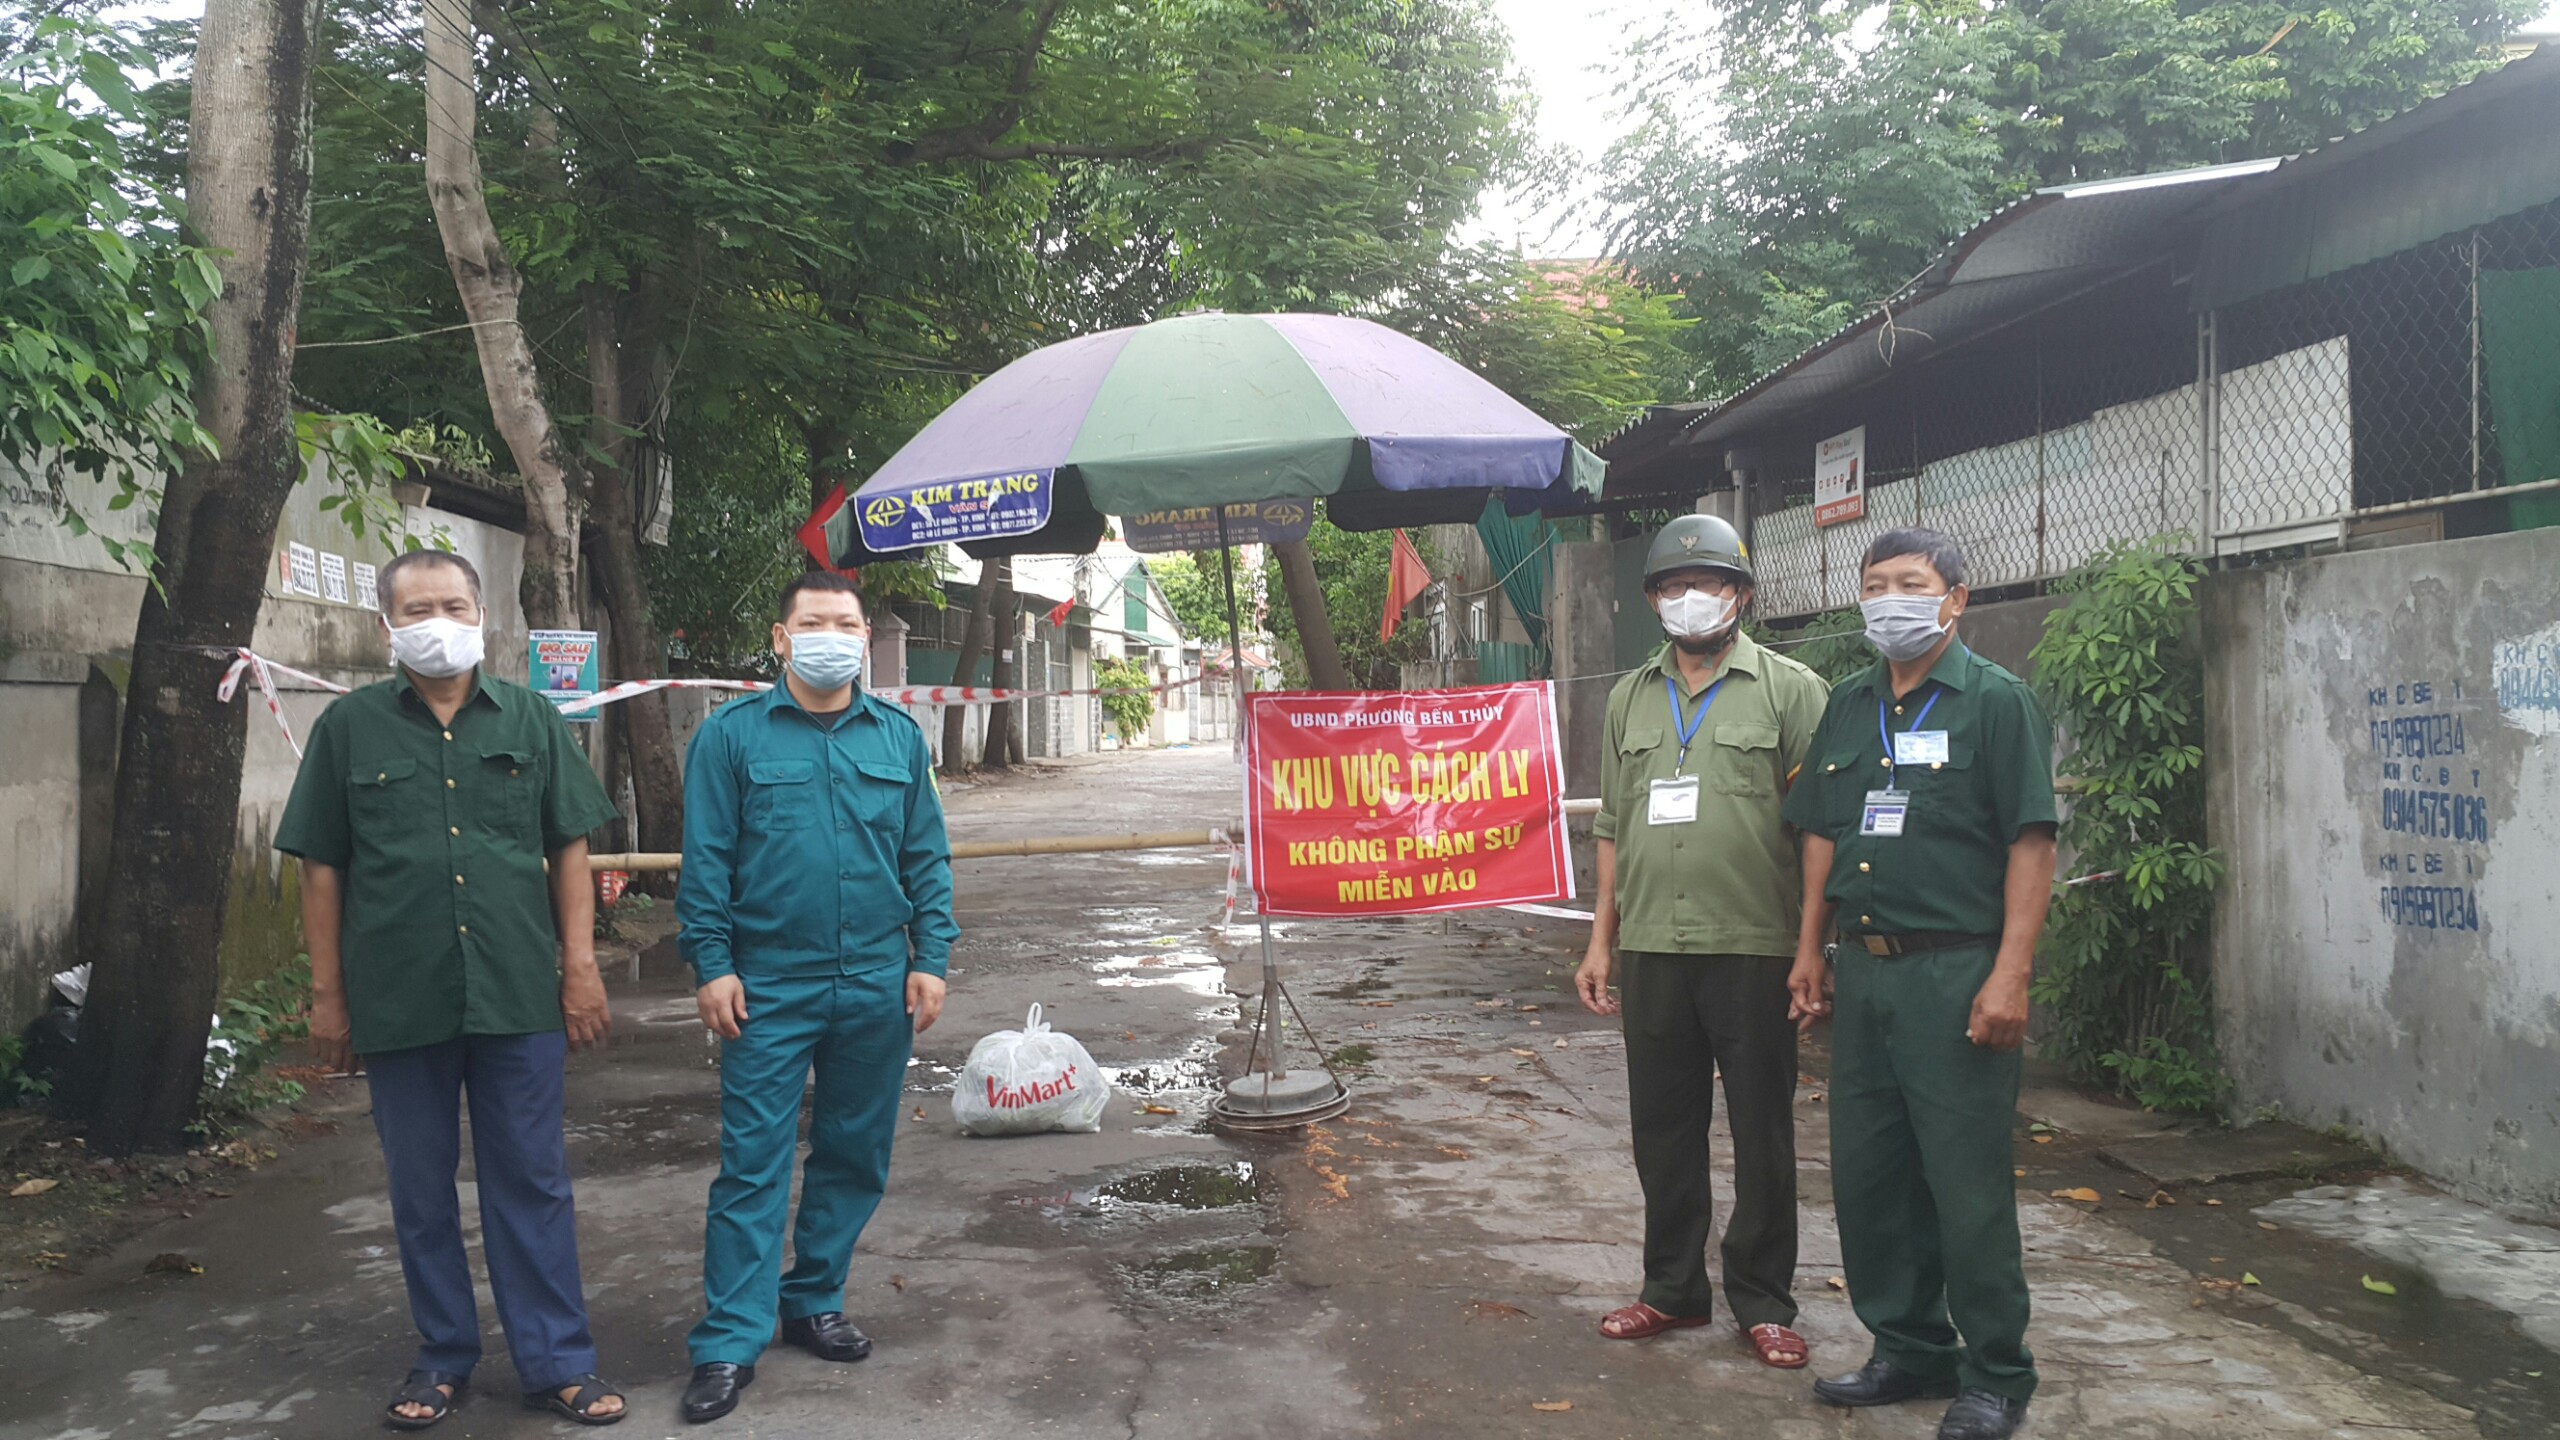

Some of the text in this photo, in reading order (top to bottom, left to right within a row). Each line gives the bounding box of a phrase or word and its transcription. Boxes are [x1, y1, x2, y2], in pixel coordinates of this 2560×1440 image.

[910, 474, 1039, 507] KIM TRANG
[562, 642, 592, 654] SALE
[2369, 687, 2388, 706] KH
[2396, 684, 2407, 705] C
[2413, 681, 2432, 704] BE
[1290, 712, 1339, 728] UBND
[1345, 707, 1415, 727] PHƯỜNG
[1420, 706, 1455, 725] BẾN
[1271, 741, 1529, 818] KHU VỰC CÁCH LY
[2383, 762, 2401, 780] KH
[2439, 767, 2450, 786] B
[2472, 769, 2481, 788] T
[1289, 822, 1525, 866] KHÔNG PHẬN SỰ
[2380, 854, 2398, 872] KH
[2407, 854, 2416, 873] C
[2425, 853, 2443, 874] BE
[1338, 867, 1477, 903] MIỄN VÀO
